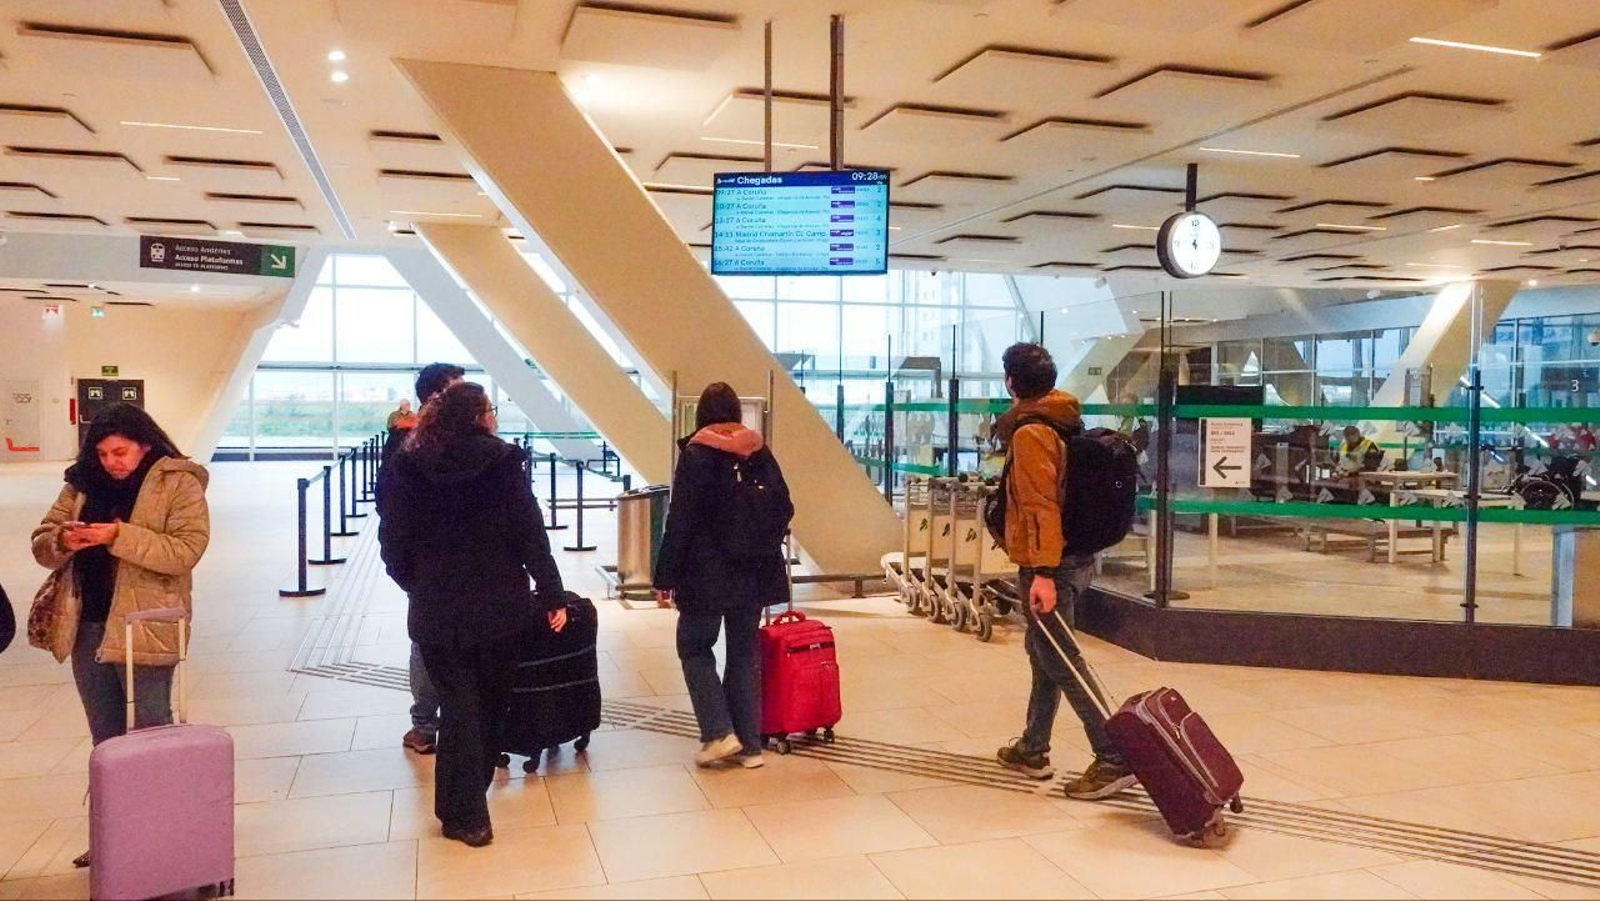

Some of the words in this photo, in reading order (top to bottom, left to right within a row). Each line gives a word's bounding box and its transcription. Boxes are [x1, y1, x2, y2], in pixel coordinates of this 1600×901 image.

[737, 175, 783, 186] Chegadas
[852, 172, 878, 181] 09:28
[175, 244, 199, 252] Acceso
[175, 254, 199, 262] Acceso
[201, 256, 243, 265] Plataformas
[1571, 379, 1580, 392] 3
